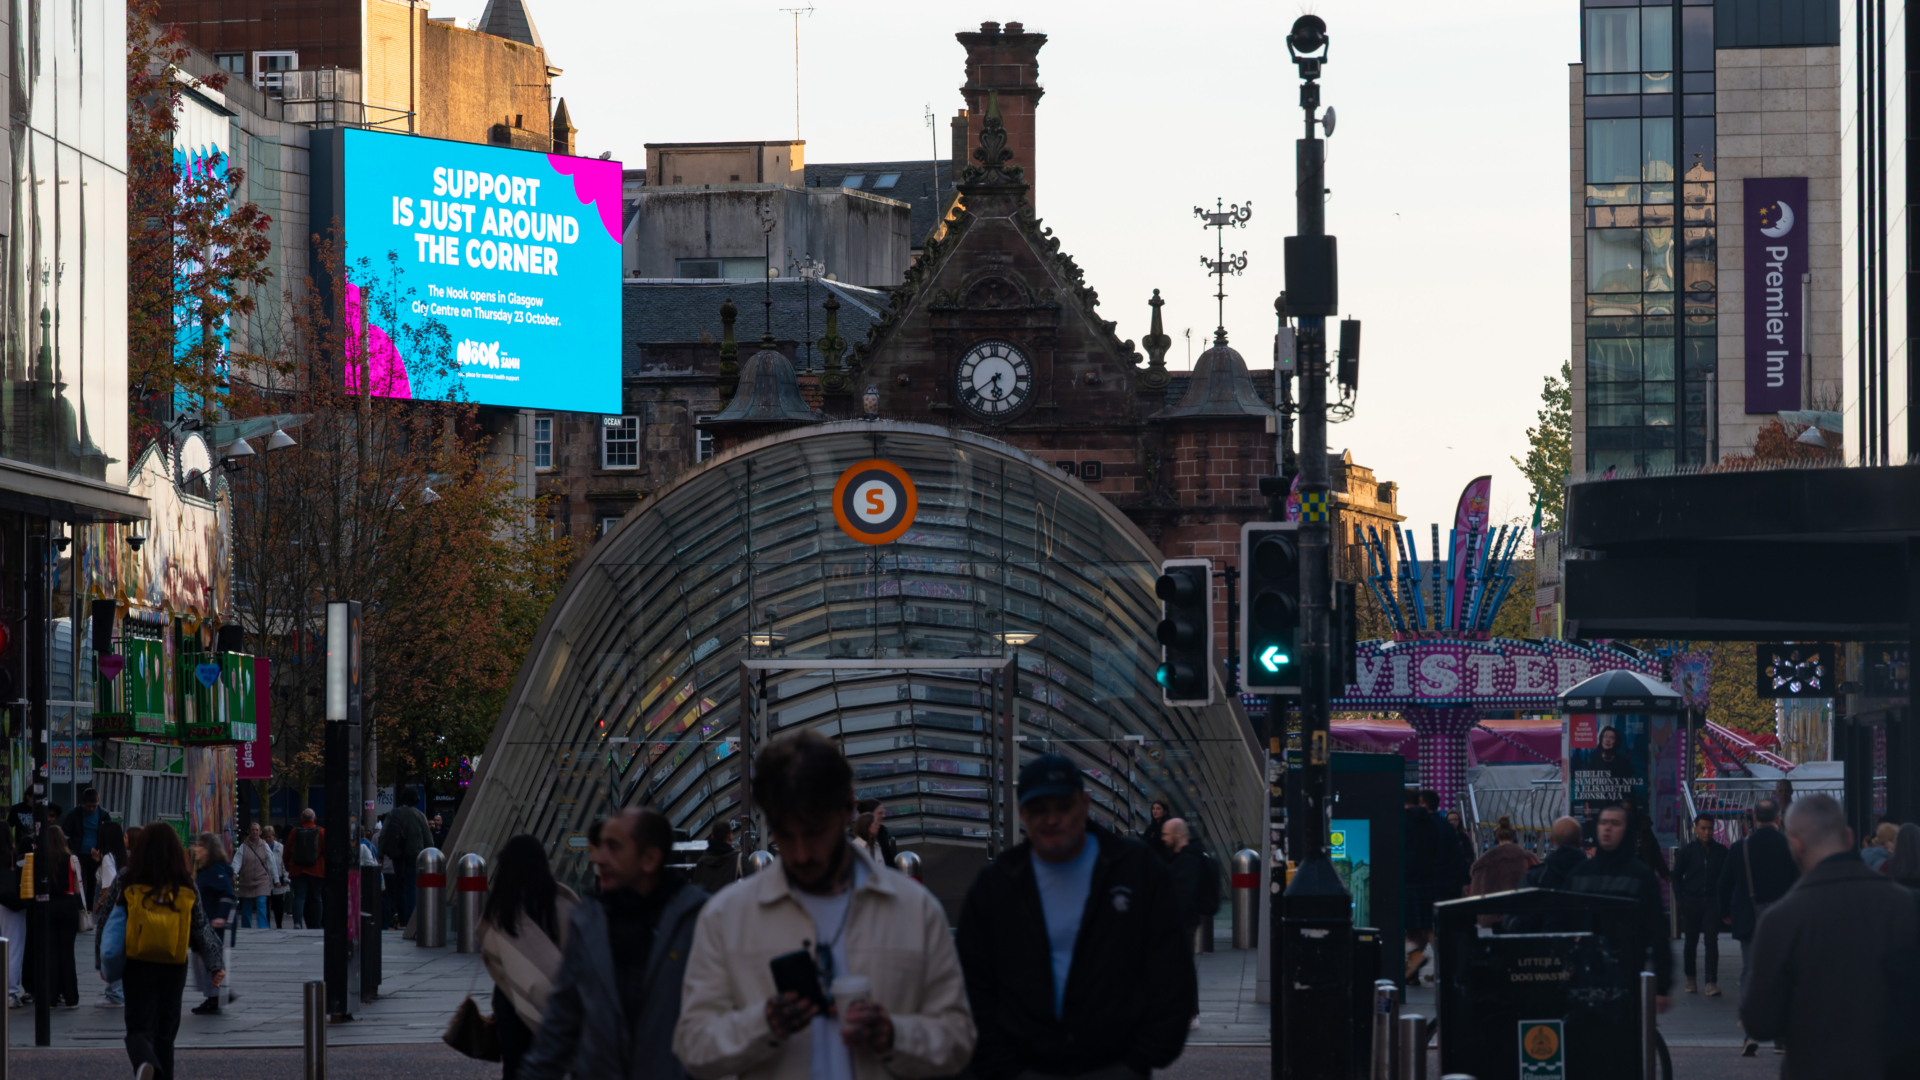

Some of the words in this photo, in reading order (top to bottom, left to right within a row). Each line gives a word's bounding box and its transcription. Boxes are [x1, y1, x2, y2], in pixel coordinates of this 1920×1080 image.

[433, 166, 541, 207] SUPPORT
[392, 195, 414, 227] IS
[419, 198, 476, 234] JUST
[481, 206, 580, 245] AROUND
[414, 232, 460, 266] THE
[465, 238, 559, 277] CORNER
[428, 284, 445, 298] The
[446, 286, 469, 300] Nook
[470, 292, 497, 304] opens
[498, 290, 506, 304] in
[507, 292, 544, 309] Glasgow
[1765, 246, 1789, 345] Premier
[411, 301, 429, 317] City
[430, 303, 460, 317] Centre
[461, 308, 472, 318] on
[473, 306, 513, 325] Thursday
[514, 310, 524, 323] 23
[525, 312, 562, 327] October.
[500, 357, 520, 370] SAMH
[1766, 350, 1789, 388] Inn
[603, 417, 622, 426] OCEAN
[864, 487, 885, 514] S
[200, 667, 216, 675] KISS
[187, 726, 224, 738] FUN
[242, 741, 255, 769] glas
[1574, 770, 1612, 778] SIBELIUS
[1574, 777, 1621, 785] SYMPHONY
[1622, 778, 1644, 786] NO.2
[1574, 785, 1580, 793] &
[1581, 785, 1632, 793] ELISABETH
[1574, 792, 1623, 801] LEONSKAJA
[1518, 958, 1552, 968] LITTER
[1511, 973, 1533, 982] DOG
[1535, 972, 1570, 982] WASTE
